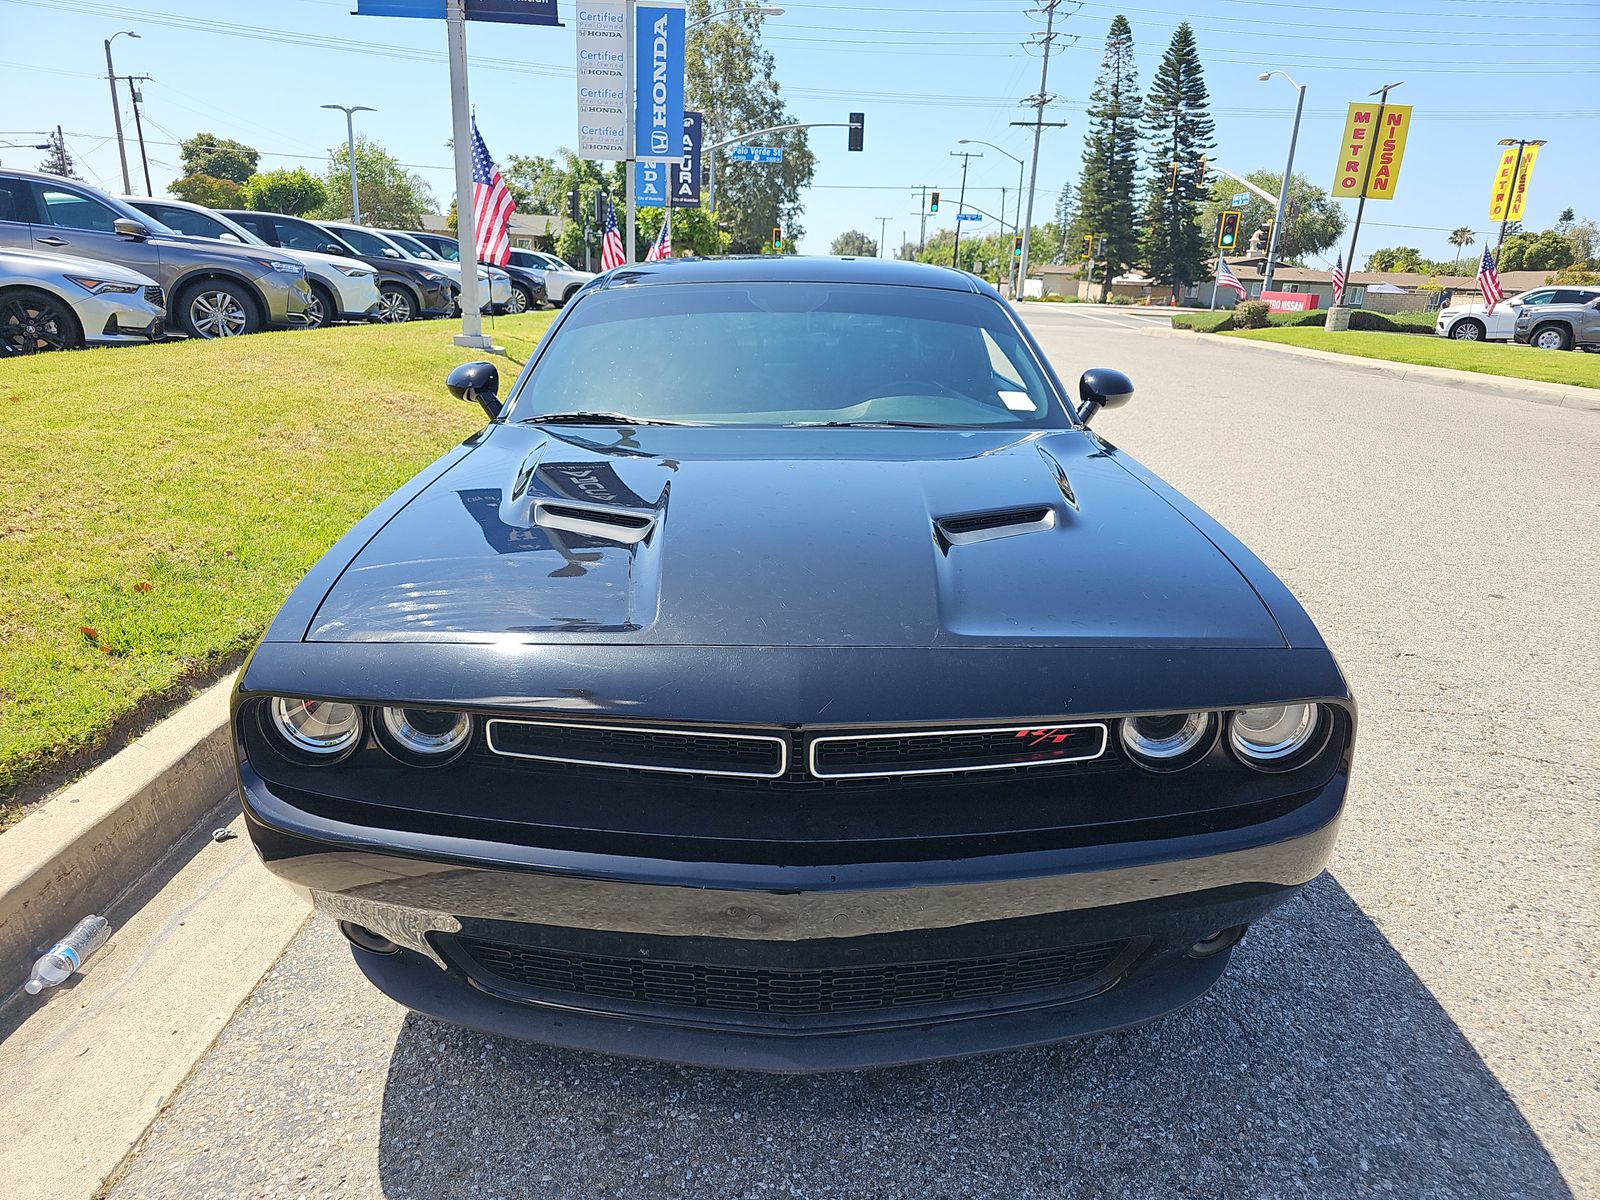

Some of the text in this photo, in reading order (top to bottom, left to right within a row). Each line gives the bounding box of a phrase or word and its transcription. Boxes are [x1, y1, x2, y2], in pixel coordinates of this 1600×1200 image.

[579, 11, 624, 23] Certified
[587, 30, 623, 38] HONDA
[580, 50, 624, 61] Certified
[652, 13, 668, 128] HONDA
[580, 87, 624, 99] Certified
[588, 106, 623, 114] HONDA
[581, 125, 624, 137] Certified
[732, 147, 781, 156] Palo Verde St
[1341, 111, 1371, 189] METRO
[1373, 113, 1402, 191] NISSAN
[643, 161, 658, 194] NDA
[1512, 153, 1533, 213] NISSAN
[1493, 155, 1513, 214] METRO
[1281, 300, 1304, 311] NISSAN
[1014, 728, 1076, 747] R/T
